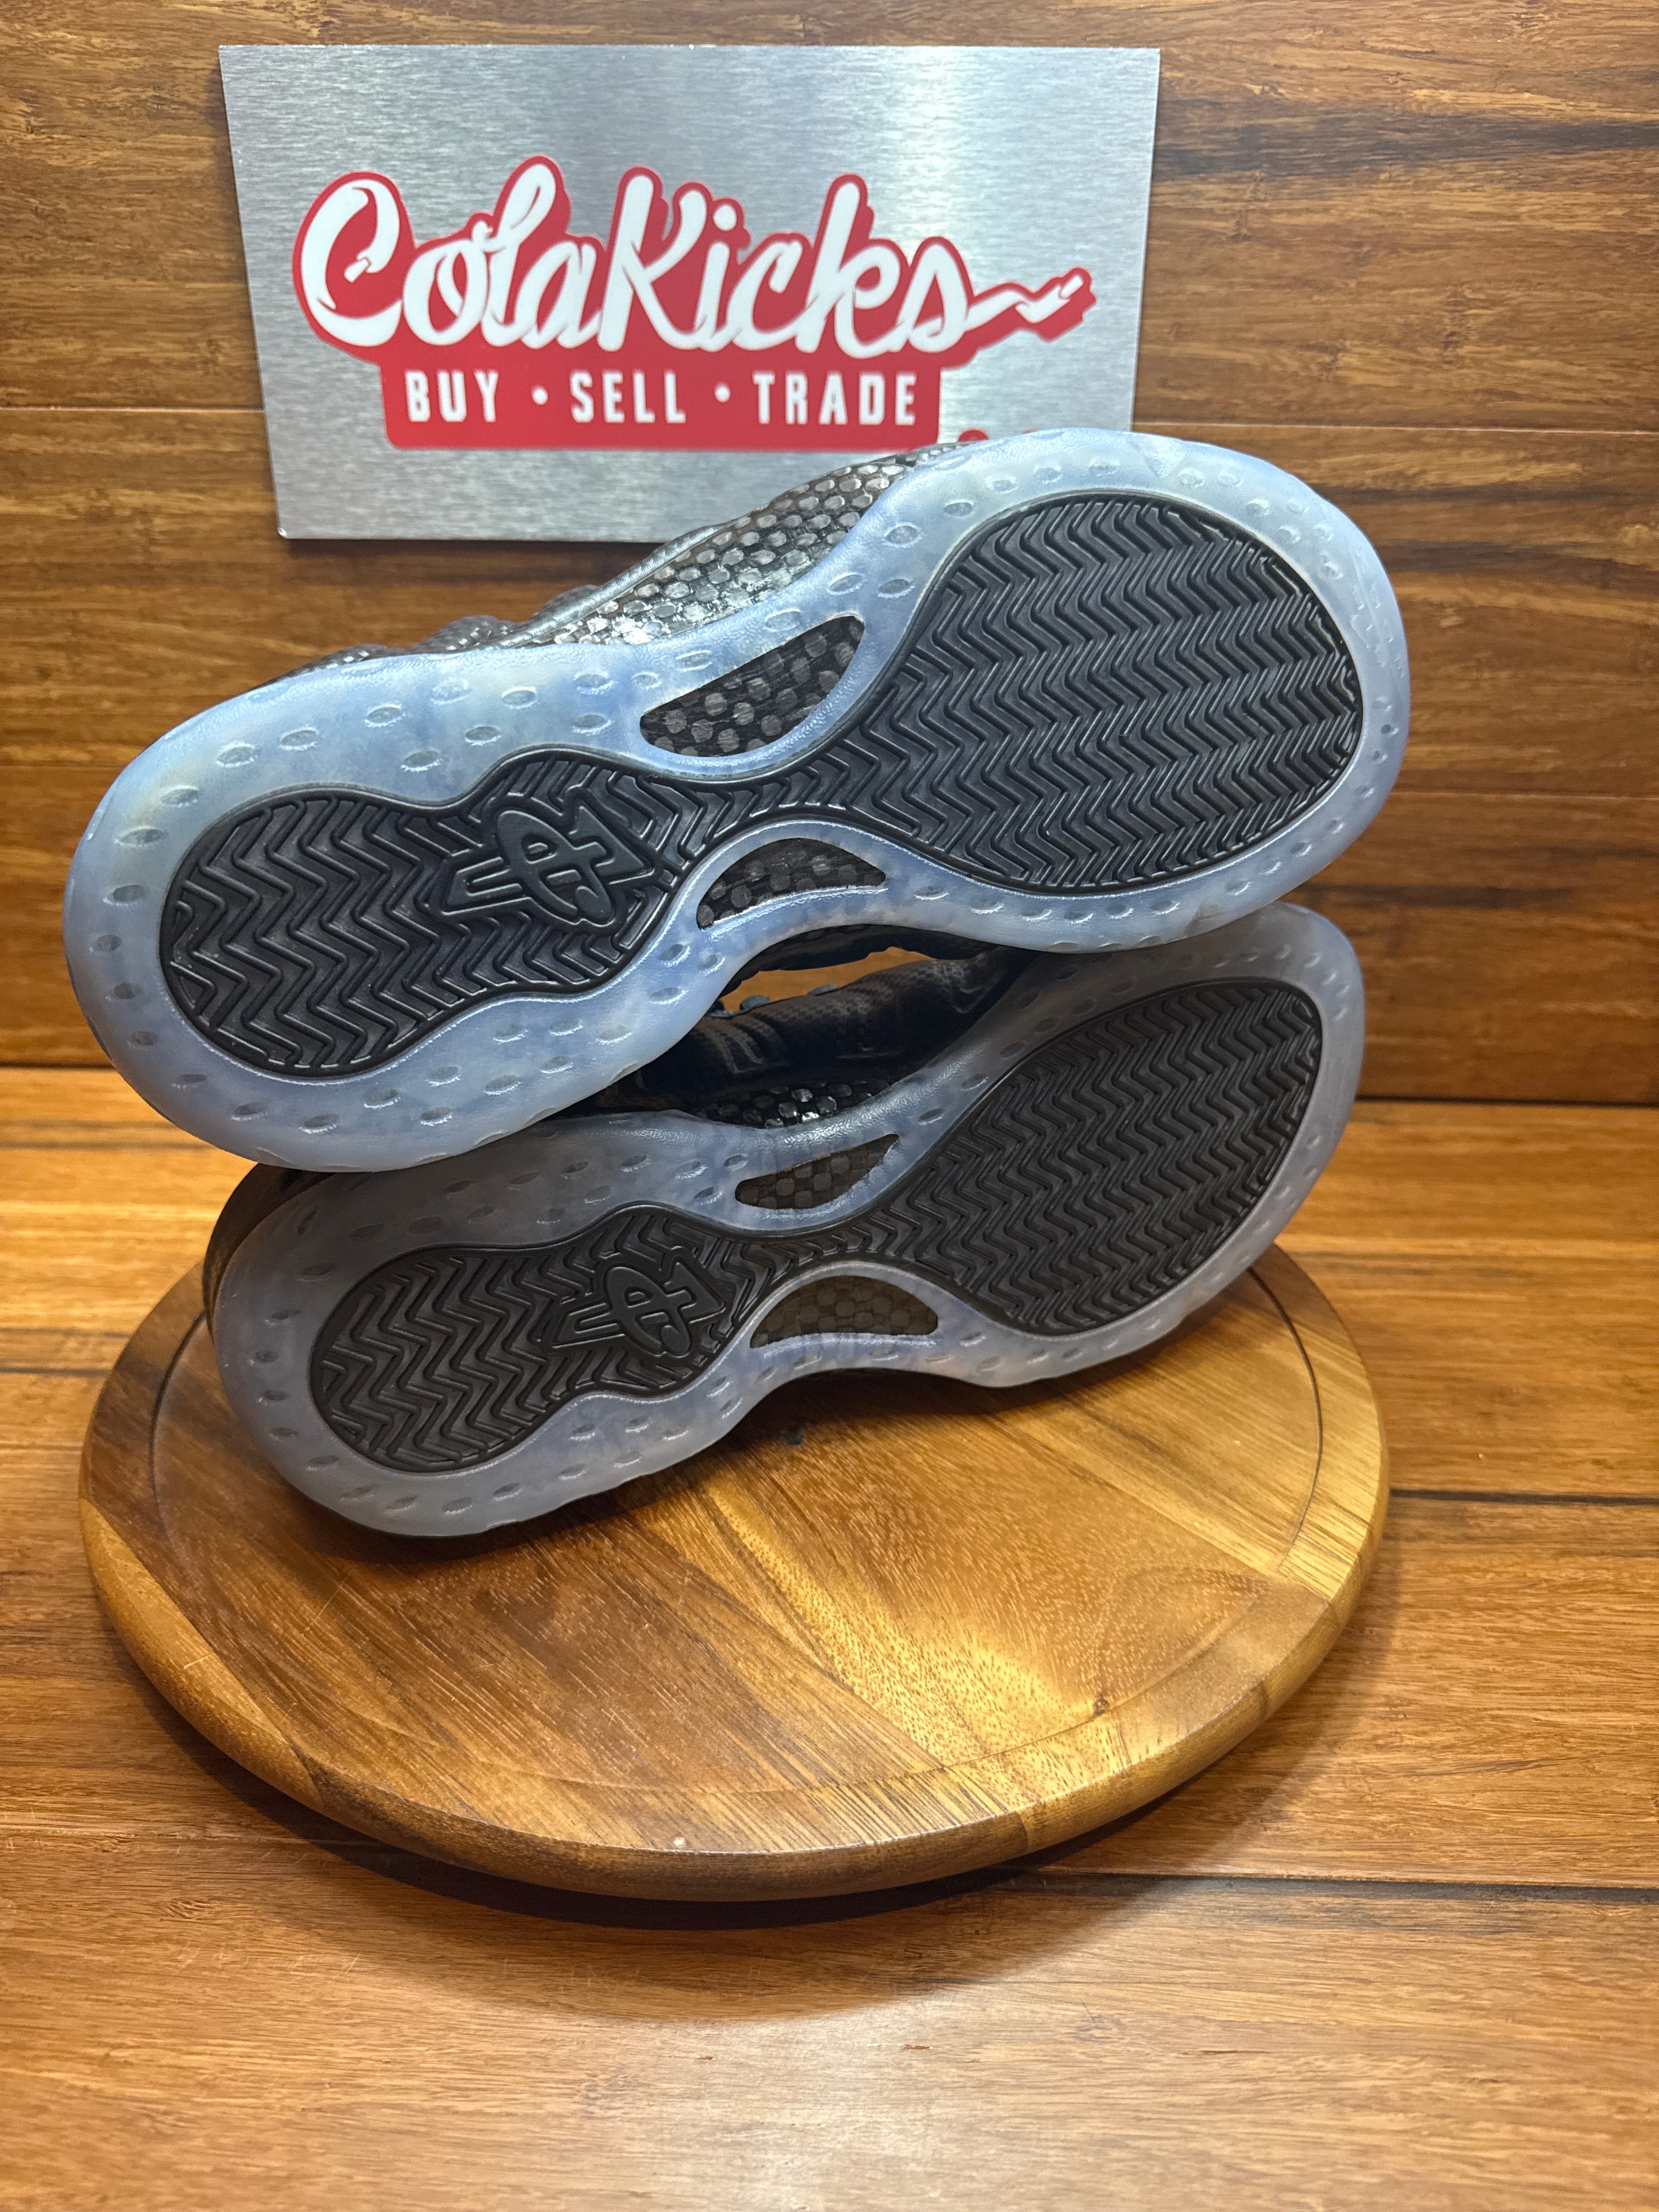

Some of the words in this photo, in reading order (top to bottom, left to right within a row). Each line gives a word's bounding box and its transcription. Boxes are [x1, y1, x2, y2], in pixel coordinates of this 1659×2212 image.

[300, 163, 1084, 359] ColaKicks
[404, 370, 499, 422] BUY
[569, 371, 686, 423] SELL
[752, 372, 917, 425] TRADE
